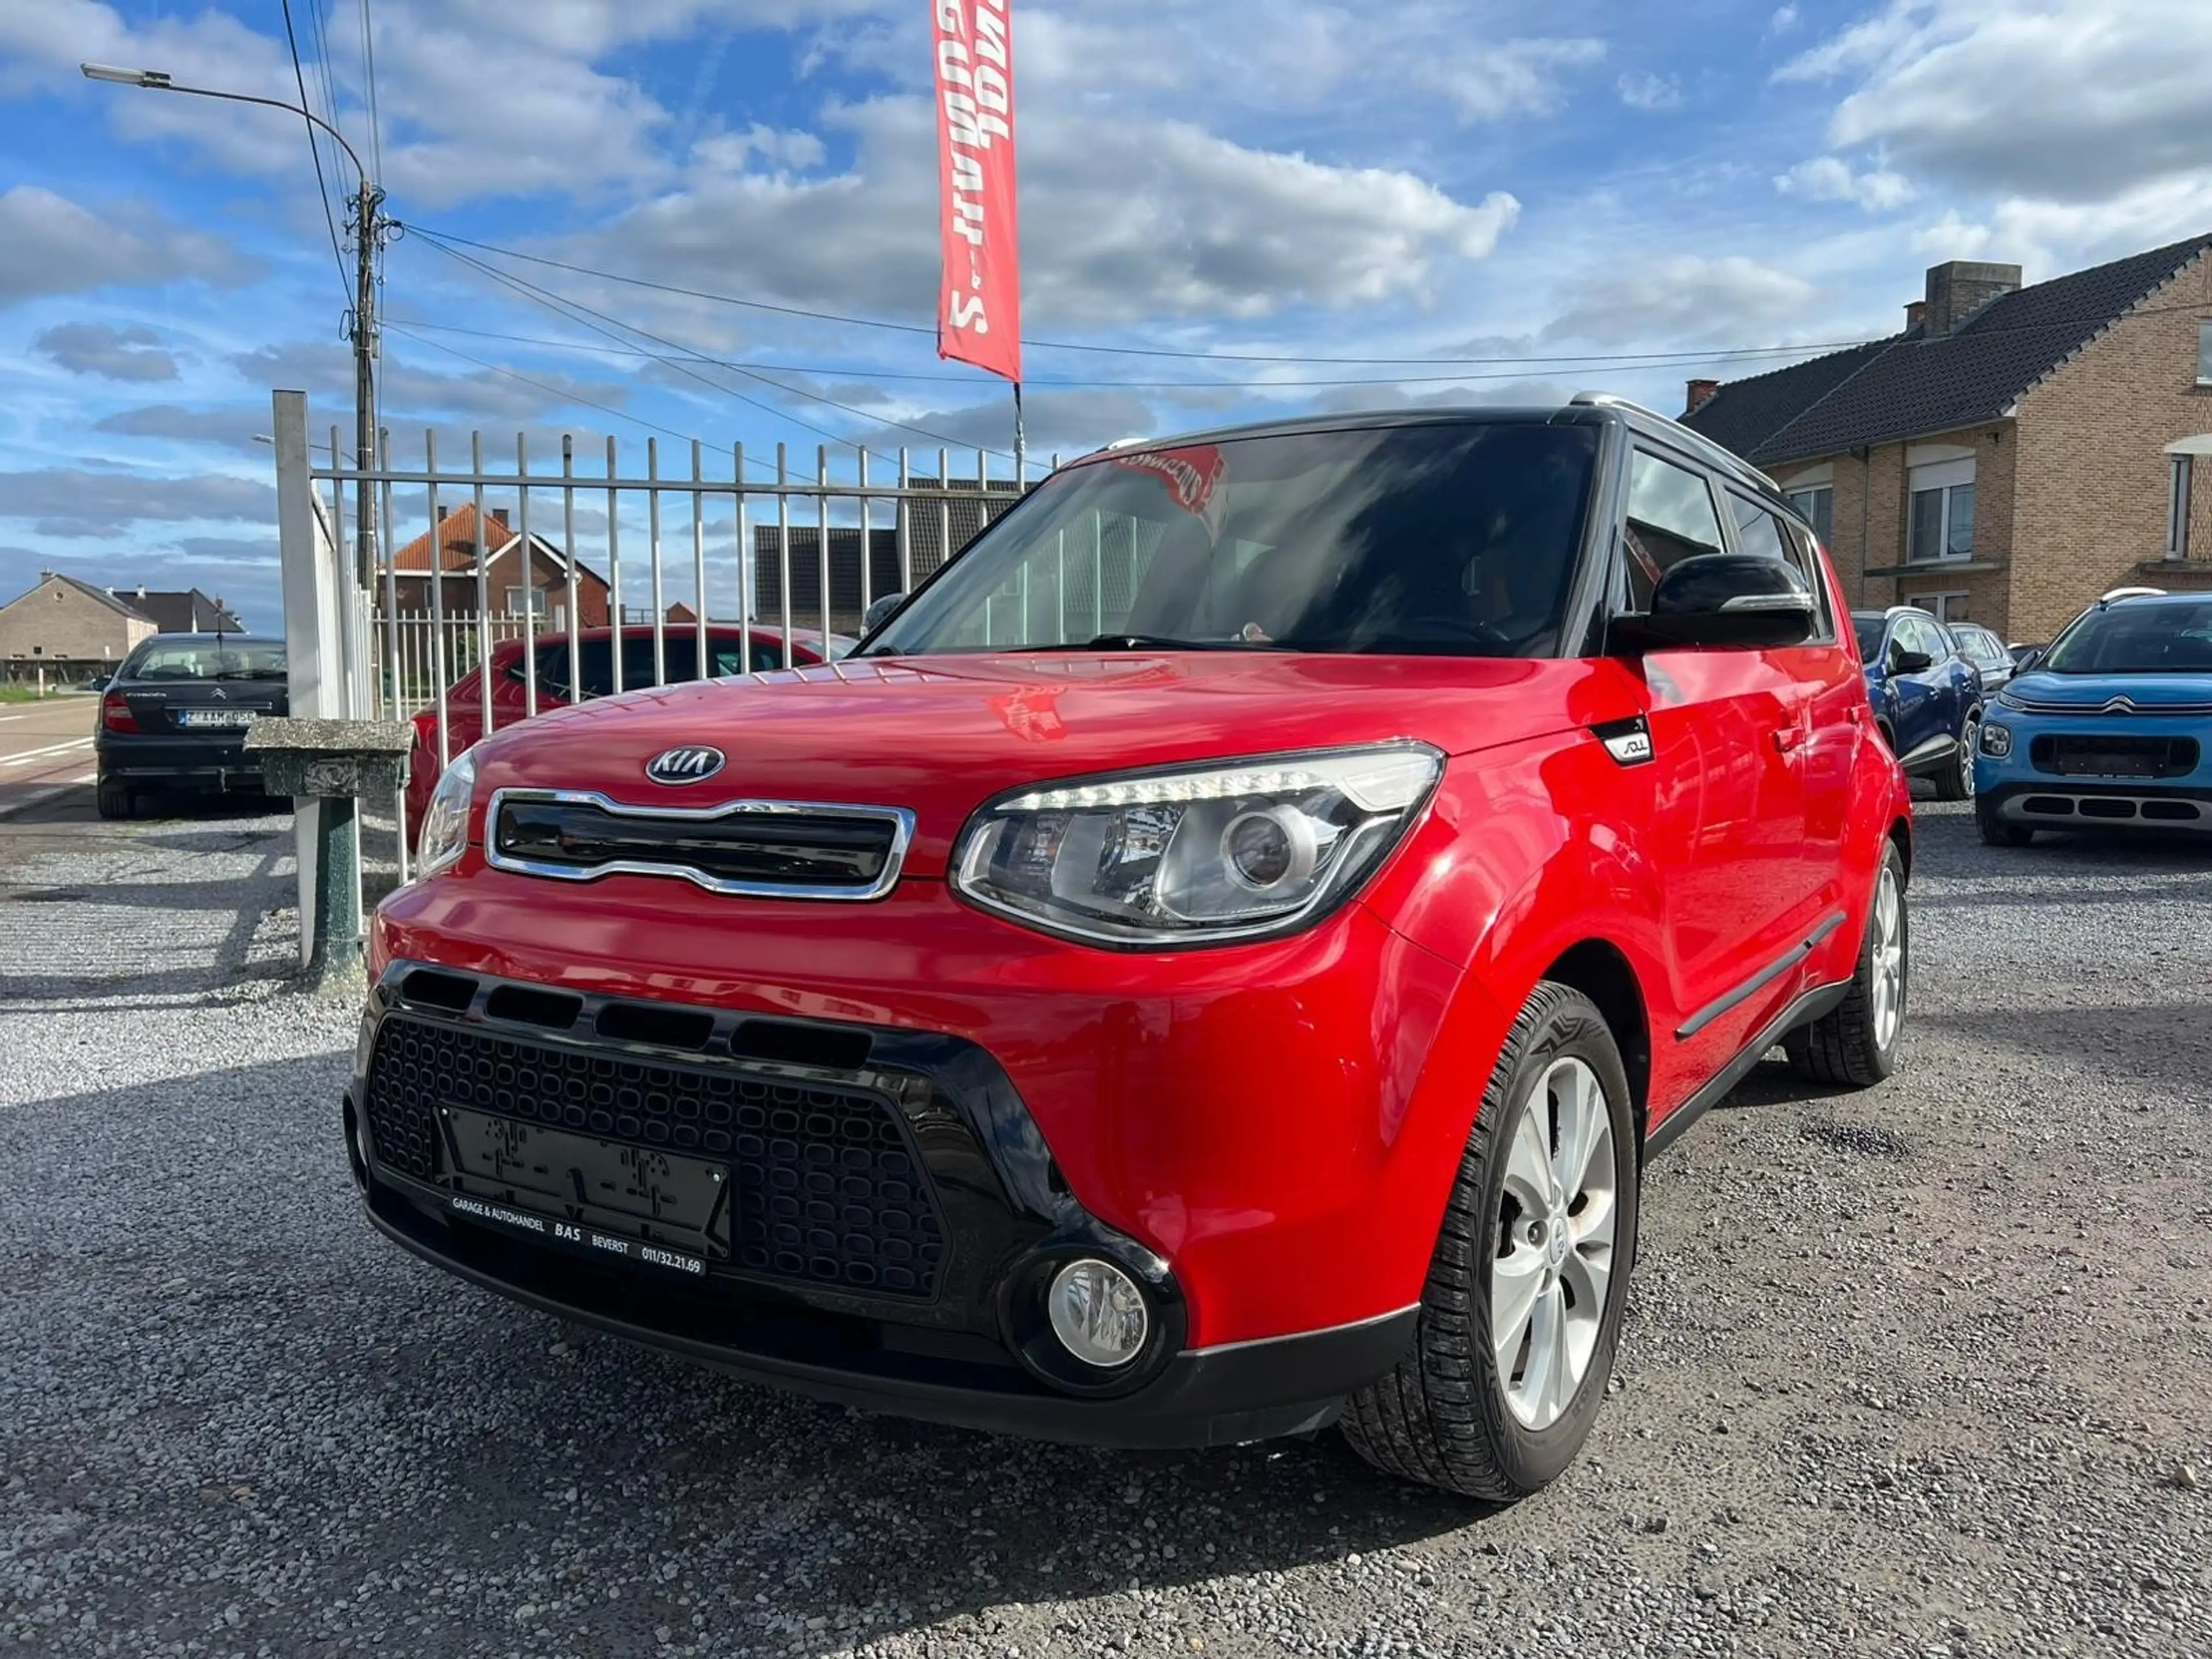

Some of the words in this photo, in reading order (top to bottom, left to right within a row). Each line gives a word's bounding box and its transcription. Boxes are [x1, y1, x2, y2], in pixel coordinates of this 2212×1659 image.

[653, 750, 709, 775] KIA
[452, 1197, 484, 1215] GARAGE
[484, 1206, 490, 1217] &
[491, 1207, 546, 1232] AUTOHANDEL
[554, 1222, 581, 1241] BAS
[591, 1234, 630, 1255] BEVERST
[641, 1247, 700, 1273] 011/32.21.69
